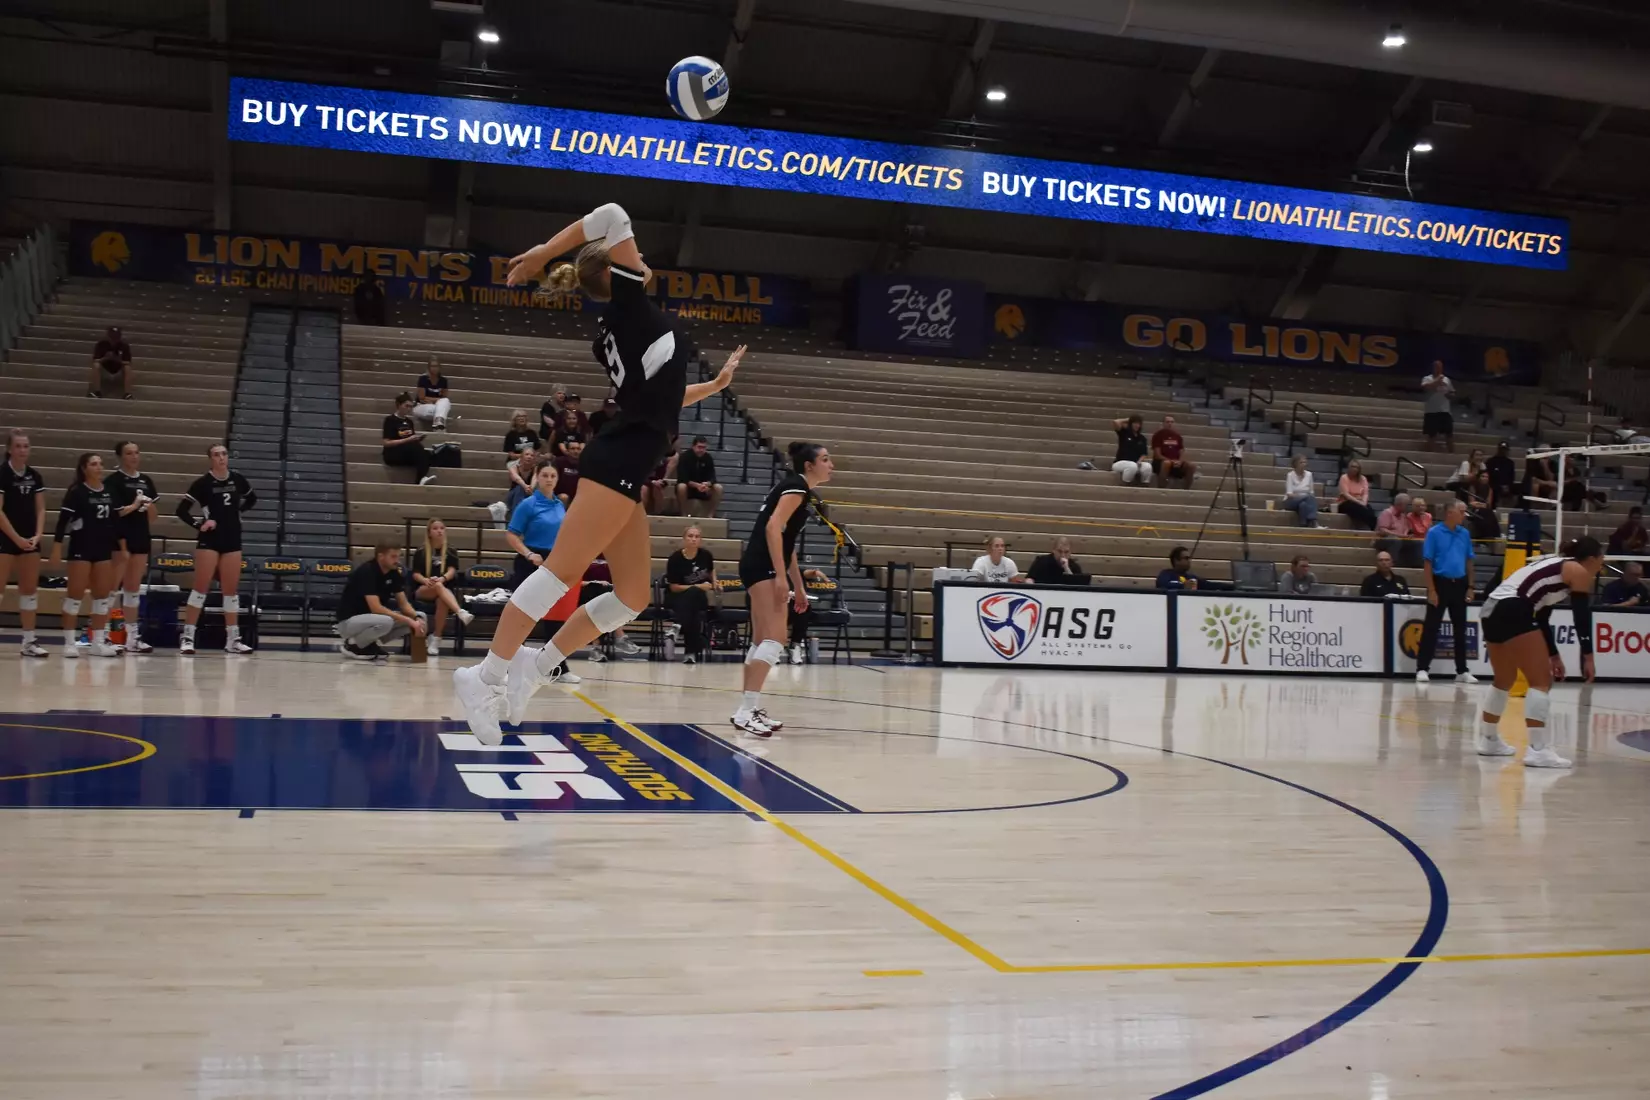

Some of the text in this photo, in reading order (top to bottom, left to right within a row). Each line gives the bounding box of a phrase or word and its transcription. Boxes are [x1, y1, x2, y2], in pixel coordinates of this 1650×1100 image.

[242, 98, 1562, 256] BUY TICKETS NOW! LIONATHLETICS.COM/TICKETS BUY TICKETS NOW! LIONATHLETICS.COM/TICKETS
[184, 232, 300, 269] LION
[319, 242, 473, 282] MEN'S
[422, 282, 466, 304] NCAA
[470, 285, 584, 313] TOURNAMENTS
[887, 284, 953, 322] Fix &
[897, 311, 957, 340] Feed
[1123, 313, 1400, 368] GO LIONS
[222, 492, 232, 506] 2
[156, 558, 194, 568] LIONS
[264, 561, 301, 571] LIONS
[316, 563, 352, 573] LIONS
[470, 569, 505, 579] LIONS
[1041, 606, 1116, 640] ASG
[1269, 603, 1314, 624] Hunt
[1269, 625, 1343, 652] Regional
[1269, 647, 1363, 669] Healthcare
